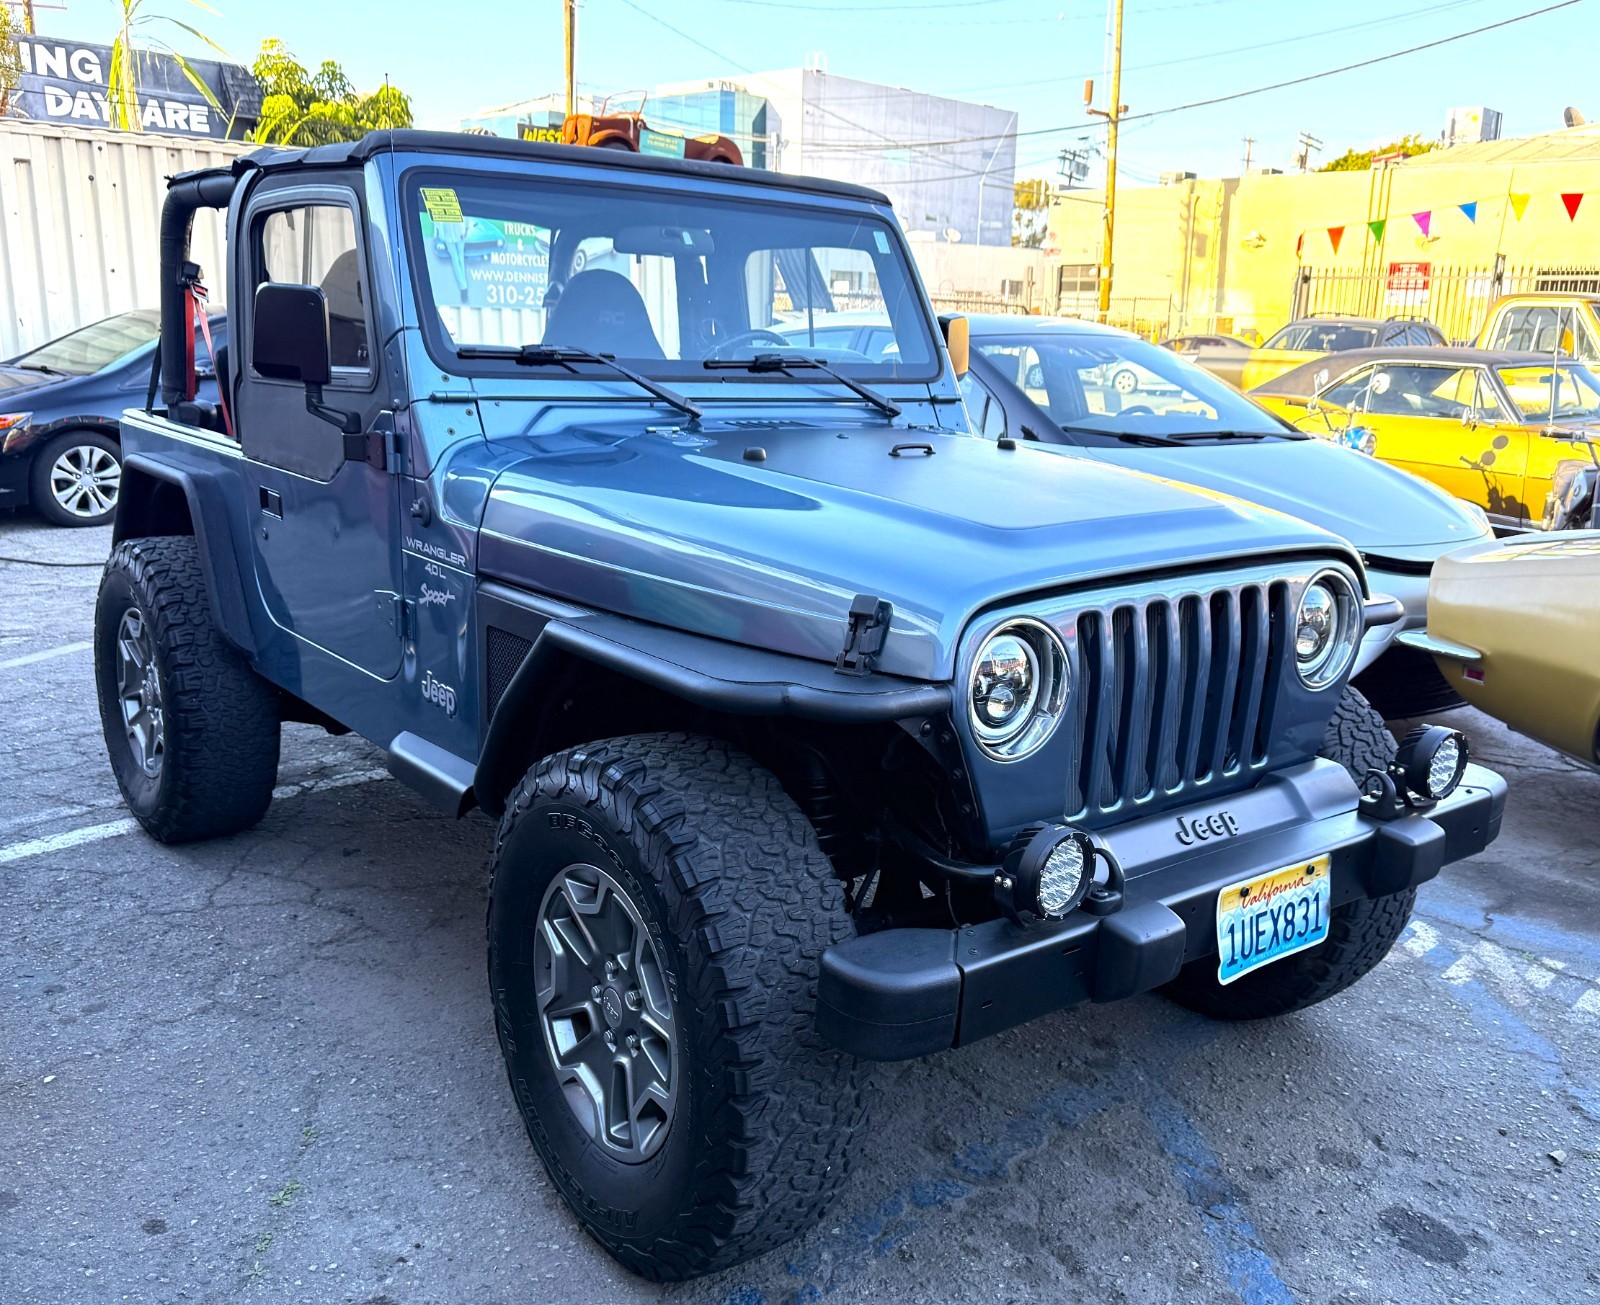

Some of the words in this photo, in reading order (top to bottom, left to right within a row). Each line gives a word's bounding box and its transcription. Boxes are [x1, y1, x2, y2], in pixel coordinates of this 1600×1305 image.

[44, 85, 211, 133] DAYARE
[503, 222, 537, 237] TRUCKS
[517, 238, 524, 251] &
[405, 536, 466, 568] WRANGLER
[421, 670, 457, 719] Jeep
[1175, 811, 1239, 845] Jeep
[1241, 878, 1312, 909] California
[1226, 891, 1323, 968] 1UEX831
